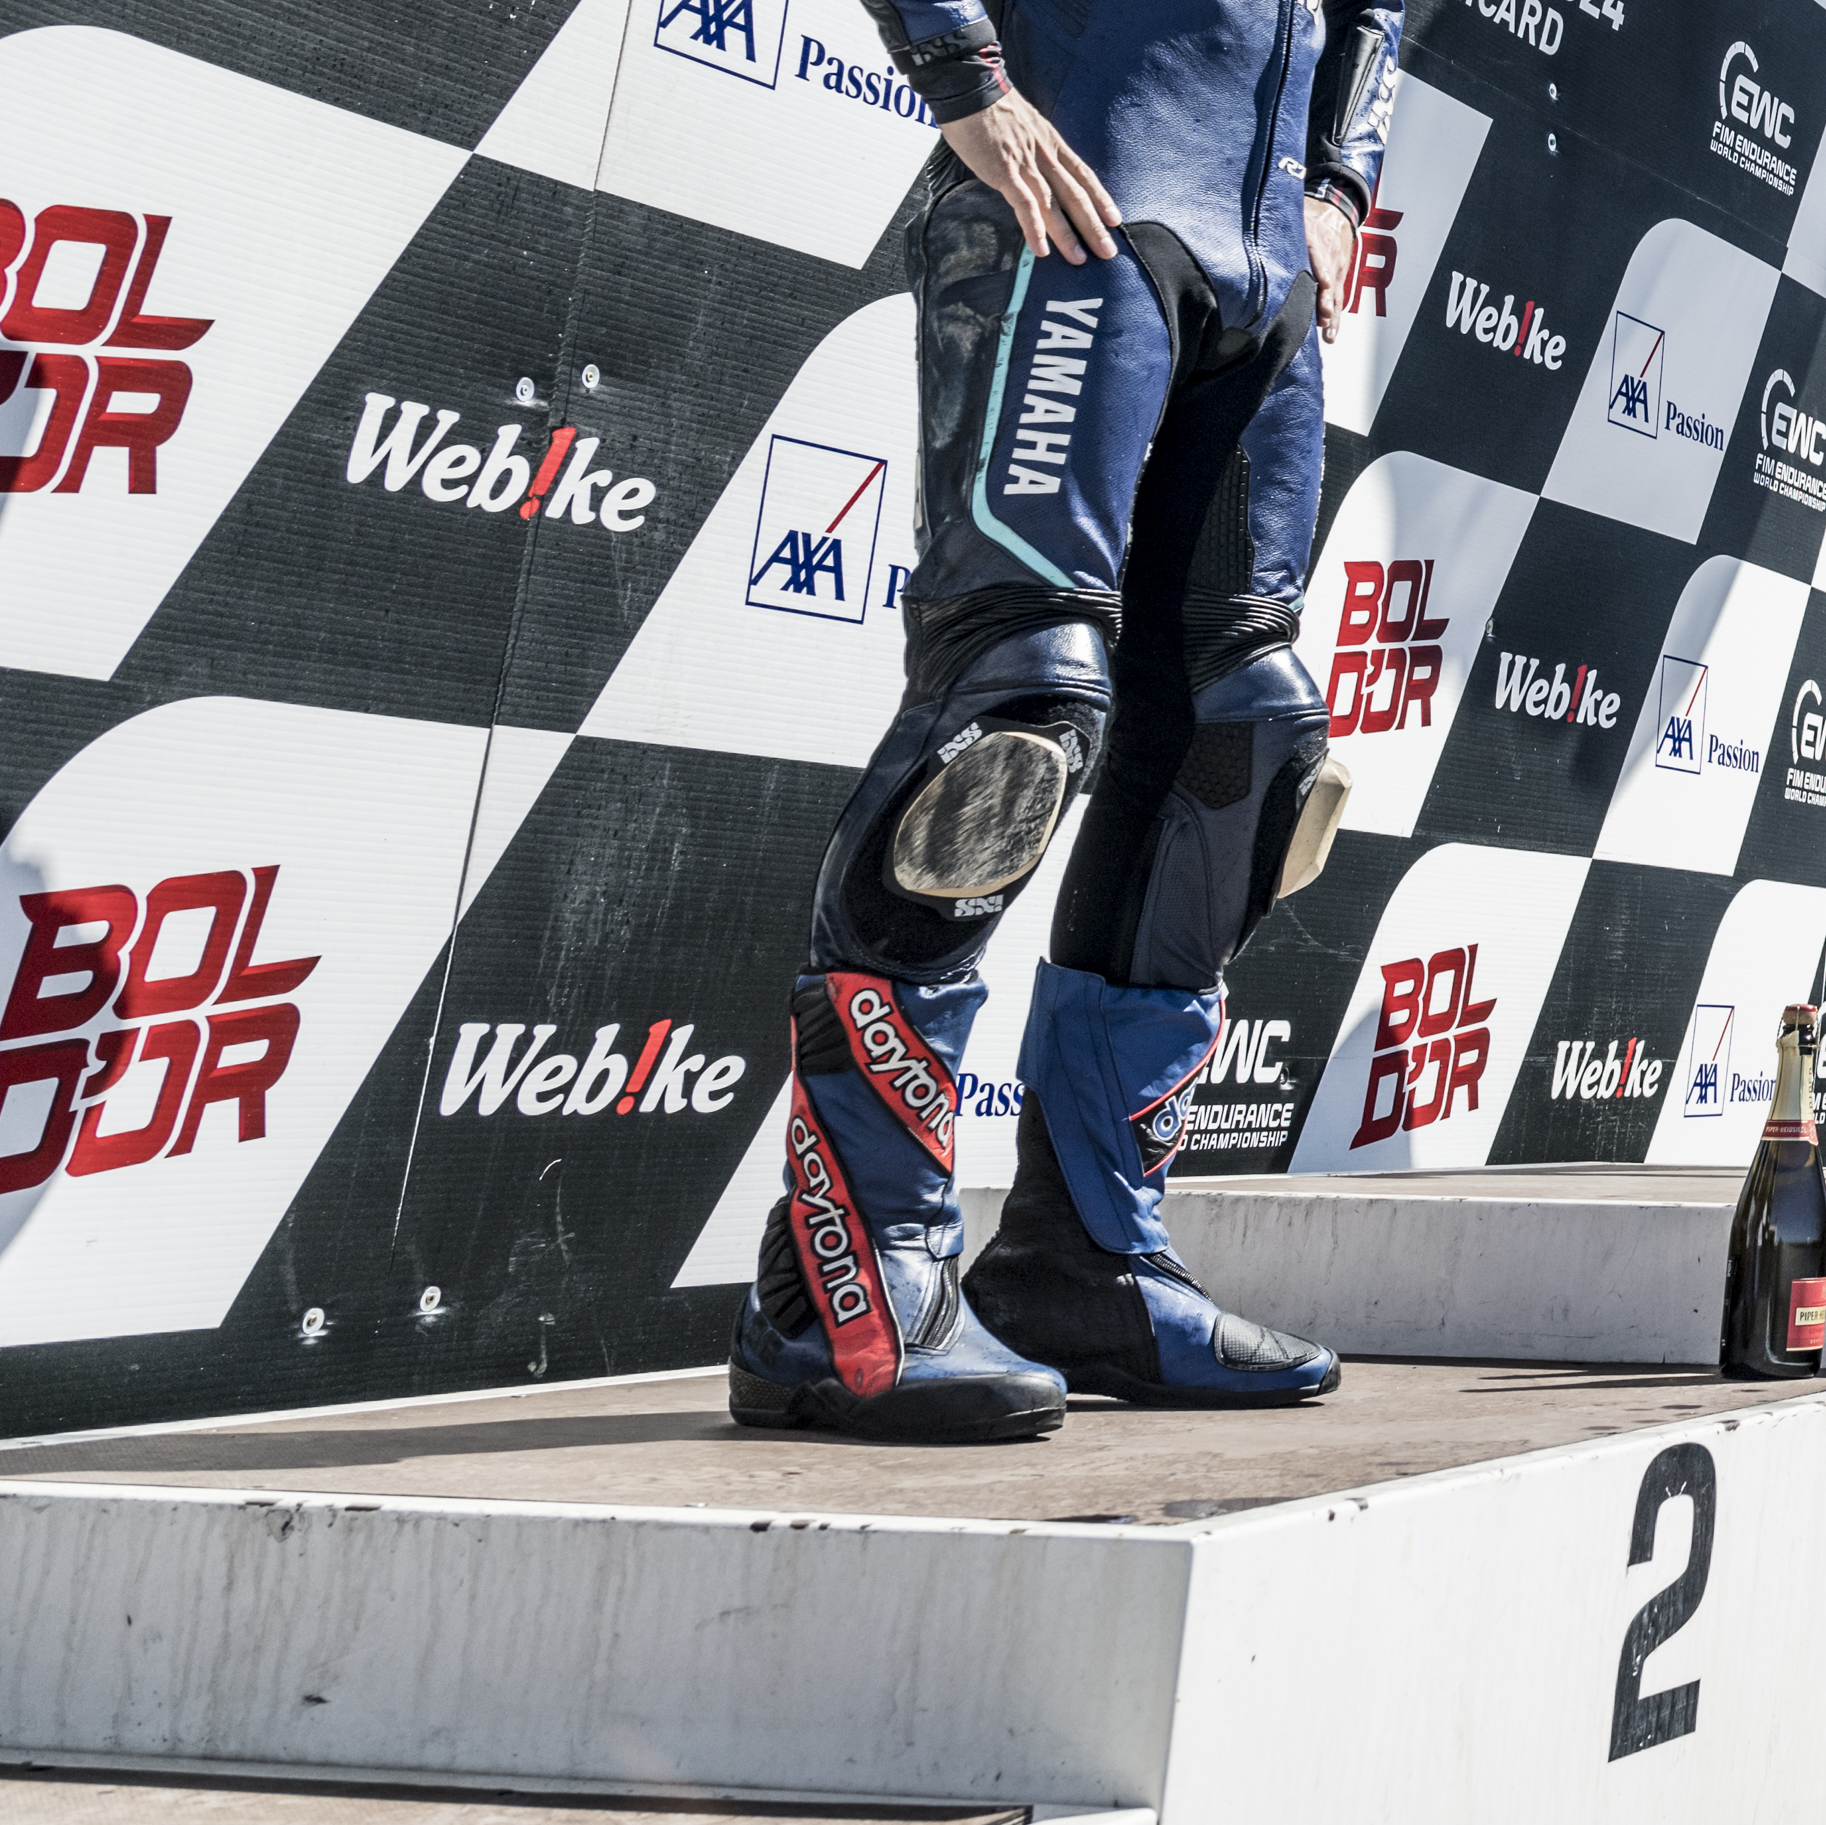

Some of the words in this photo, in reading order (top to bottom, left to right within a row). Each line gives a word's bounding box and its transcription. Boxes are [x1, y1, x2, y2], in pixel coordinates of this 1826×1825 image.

[1733, 73, 1796, 149] EWC
[1709, 138, 1738, 168] WORLD
[1739, 153, 1795, 197] CHAMPIONSHIP
[1712, 120, 1735, 147] FIM
[1735, 134, 1798, 185] ENDURANCE
[1003, 295, 1103, 497] YAMAHA
[1610, 374, 1649, 423] AXA
[1665, 400, 1725, 452] Passion
[1753, 472, 1778, 492] WORLD
[1778, 481, 1826, 512] CHAMPIONSHIP
[1755, 453, 1774, 475] FIM
[752, 530, 846, 601] AXA
[1336, 559, 1451, 648] BOL
[1657, 715, 1694, 762] AXA
[1707, 733, 1760, 775] Passion
[1784, 787, 1806, 804] WORLD
[1786, 767, 1804, 789] FIM
[0, 864, 323, 1038] BOL
[1376, 943, 1498, 1052] BOL
[1350, 1029, 1492, 1151] D'OR
[1685, 1062, 1719, 1105] AXA
[1190, 1130, 1289, 1150] CHAMPIONSHIP
[791, 1117, 870, 1327] daytona
[1607, 1441, 1718, 1764] 2
